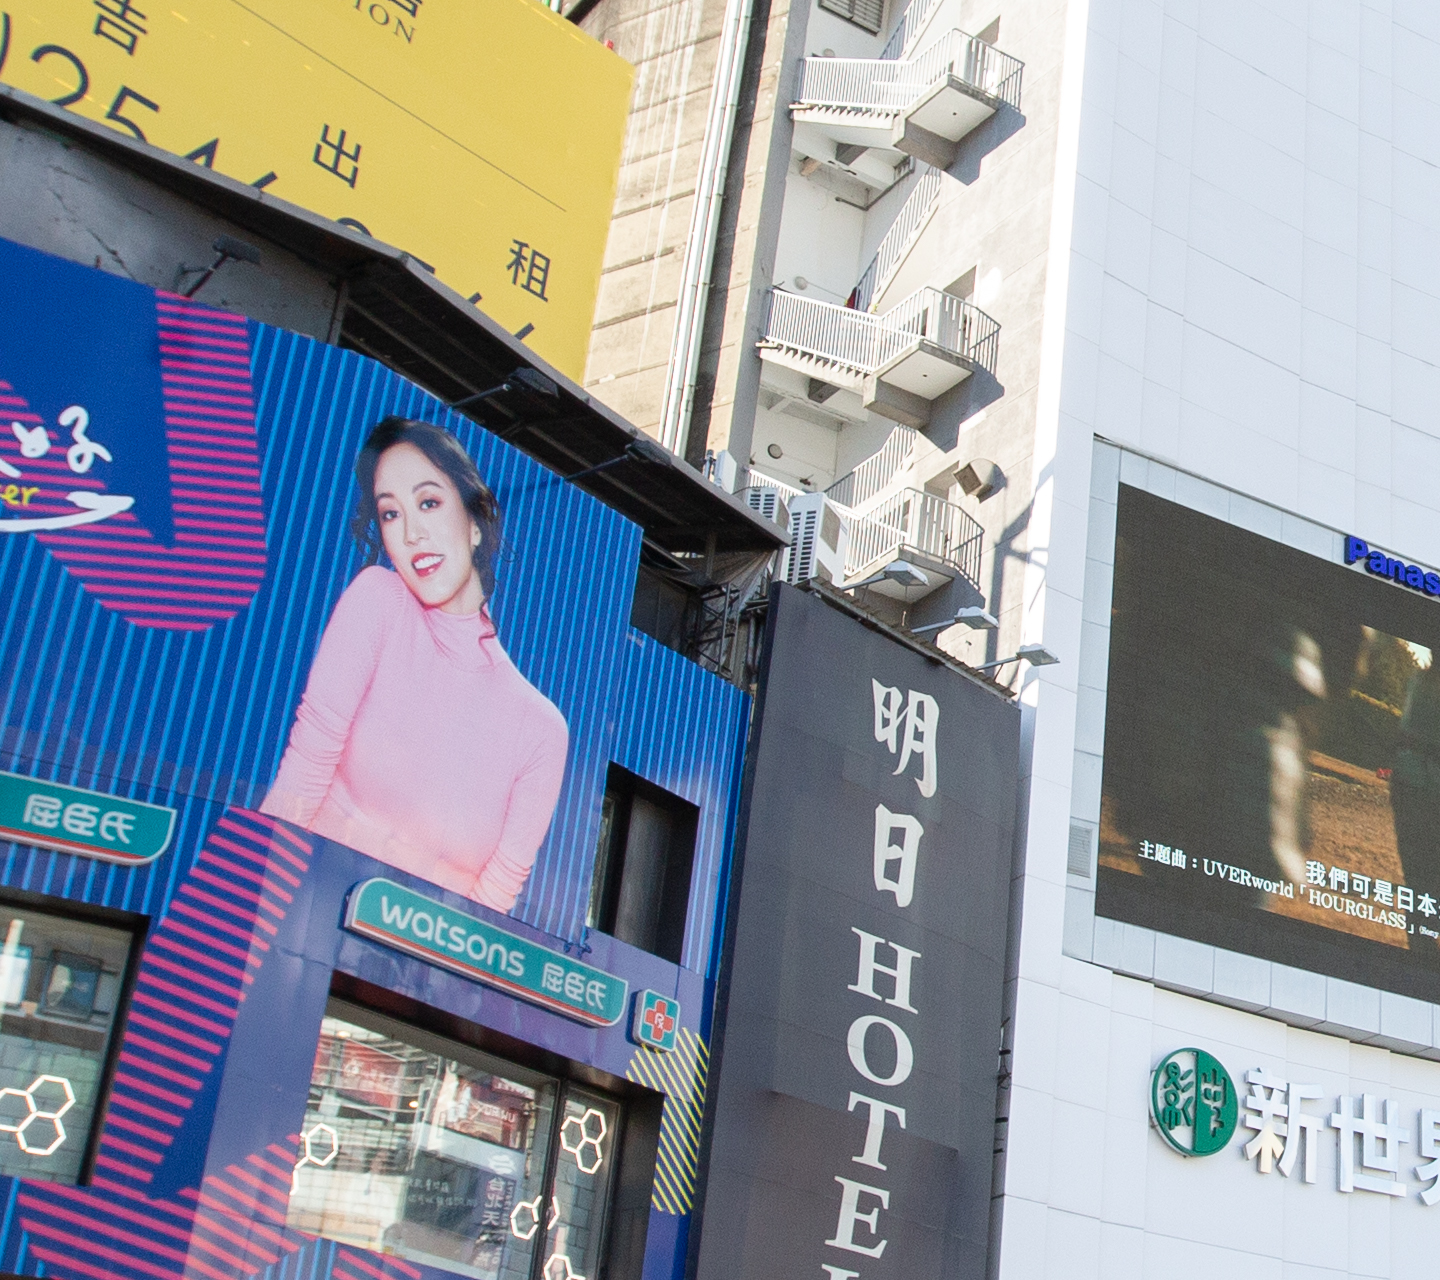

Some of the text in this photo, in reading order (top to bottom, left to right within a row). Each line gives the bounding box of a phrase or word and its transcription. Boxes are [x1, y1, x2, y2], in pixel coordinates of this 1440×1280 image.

[22, 792, 136, 846] 屈臣氏
[872, 678, 940, 907] 明日
[382, 894, 607, 1012] watsons 屈臣氏
